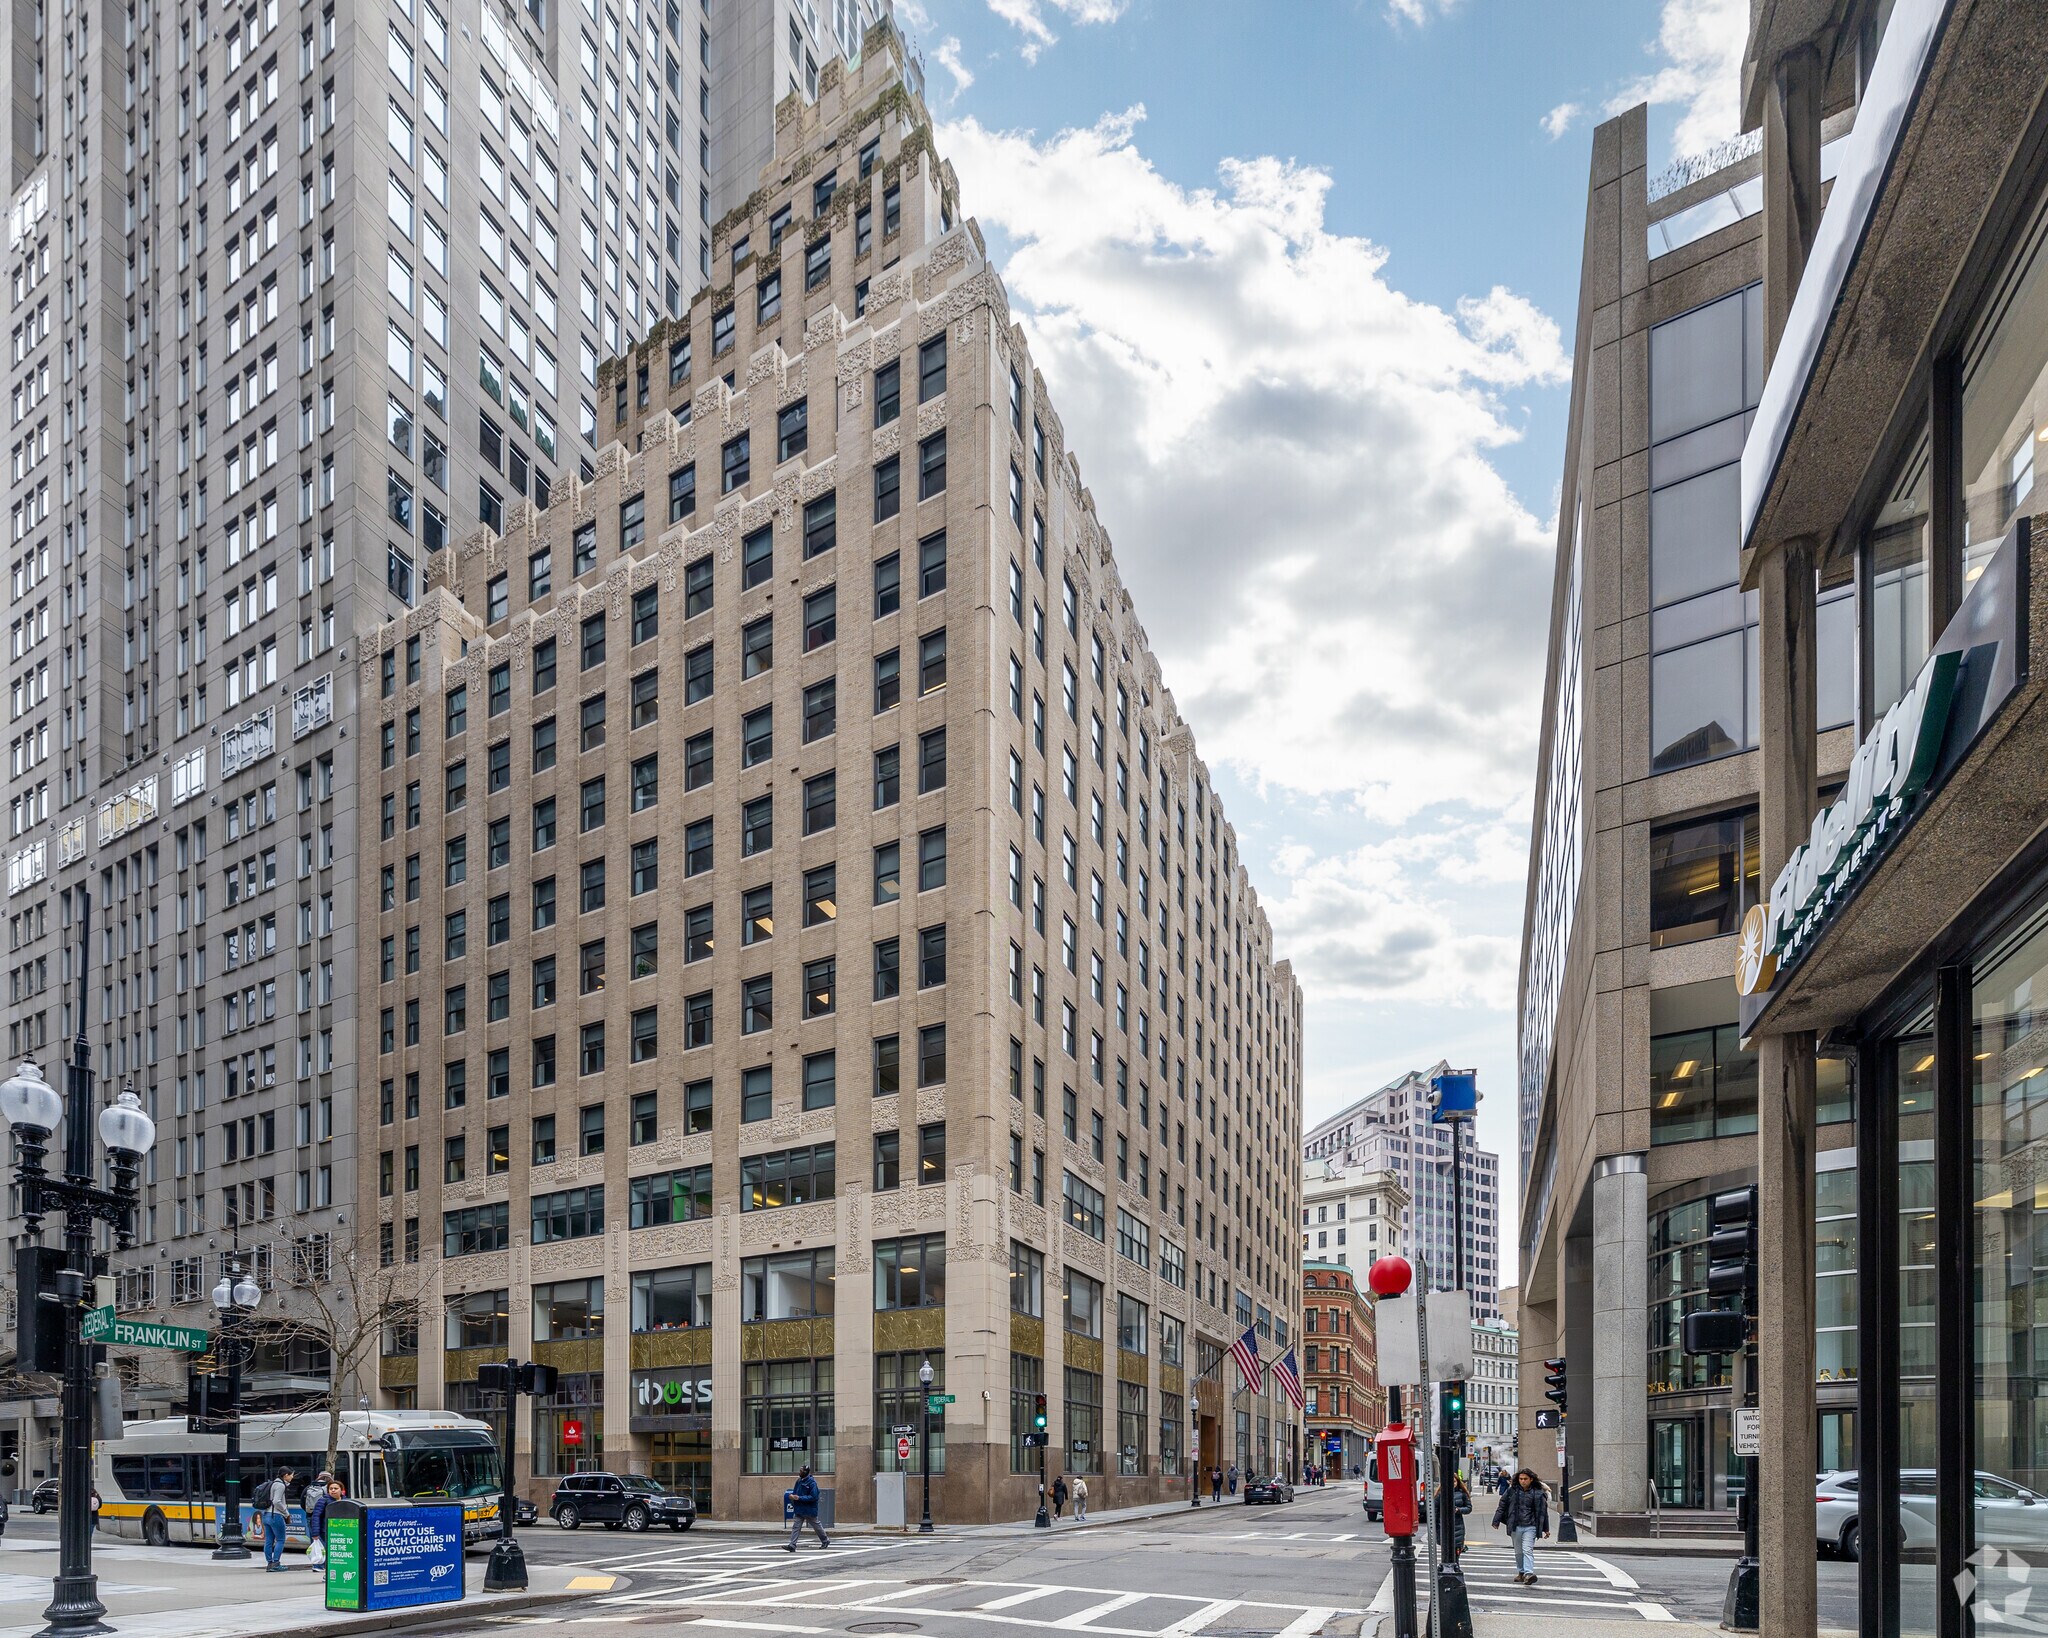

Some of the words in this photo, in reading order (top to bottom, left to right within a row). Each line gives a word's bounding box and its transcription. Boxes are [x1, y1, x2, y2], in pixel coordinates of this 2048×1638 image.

[1766, 652, 1943, 956] Fidelity
[1776, 796, 1902, 972] INVESTMENTS
[85, 1309, 109, 1335] FEDERAL
[115, 1324, 190, 1347] FRANKLIN
[192, 1339, 201, 1349] ST
[639, 1378, 712, 1406] iboss
[374, 1520, 397, 1528] Boston
[374, 1528, 400, 1538] HOW
[402, 1528, 415, 1536] TO
[417, 1526, 435, 1535] USE
[374, 1537, 408, 1547] BEACH
[410, 1534, 444, 1545] CHAIRS
[445, 1534, 456, 1542] IN
[374, 1543, 447, 1556] SNOWSTORMS.
